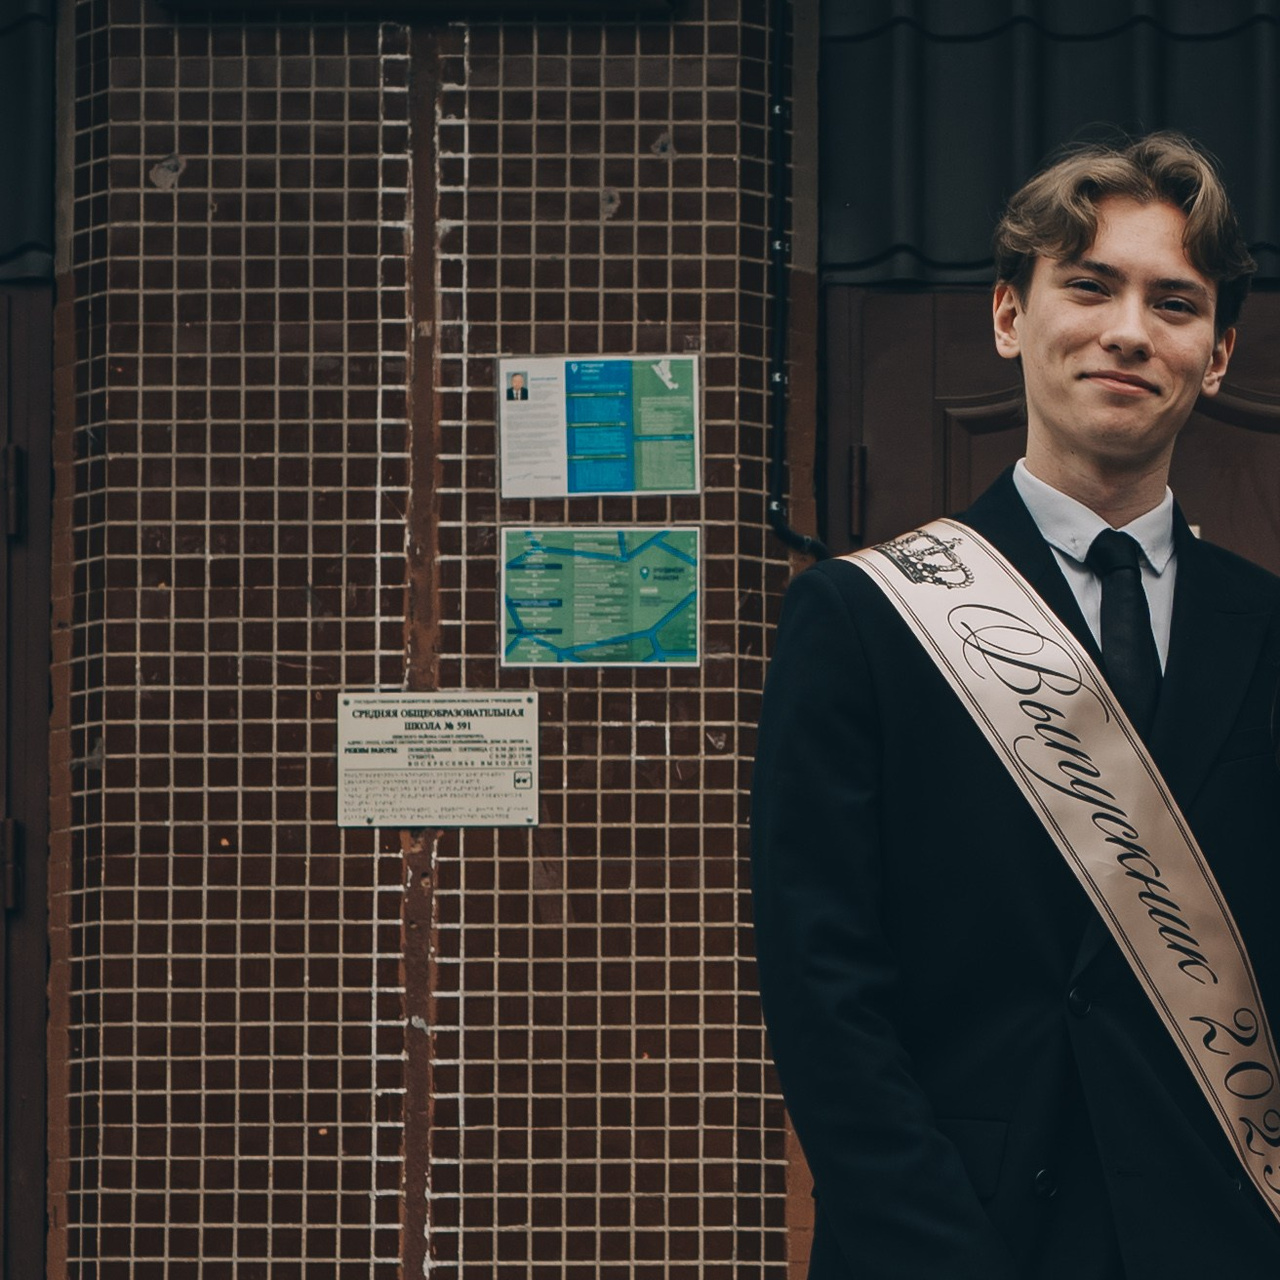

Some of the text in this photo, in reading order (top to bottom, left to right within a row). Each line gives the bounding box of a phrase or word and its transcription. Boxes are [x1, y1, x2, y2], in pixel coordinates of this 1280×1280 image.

[352, 708, 524, 719] СРЕДНЯЯ ОБЩЕОБРАЗОВАТЕЛЬНАЯ
[404, 721, 471, 731] ШКОЛА № 591
[947, 603, 1218, 985] Выпускник
